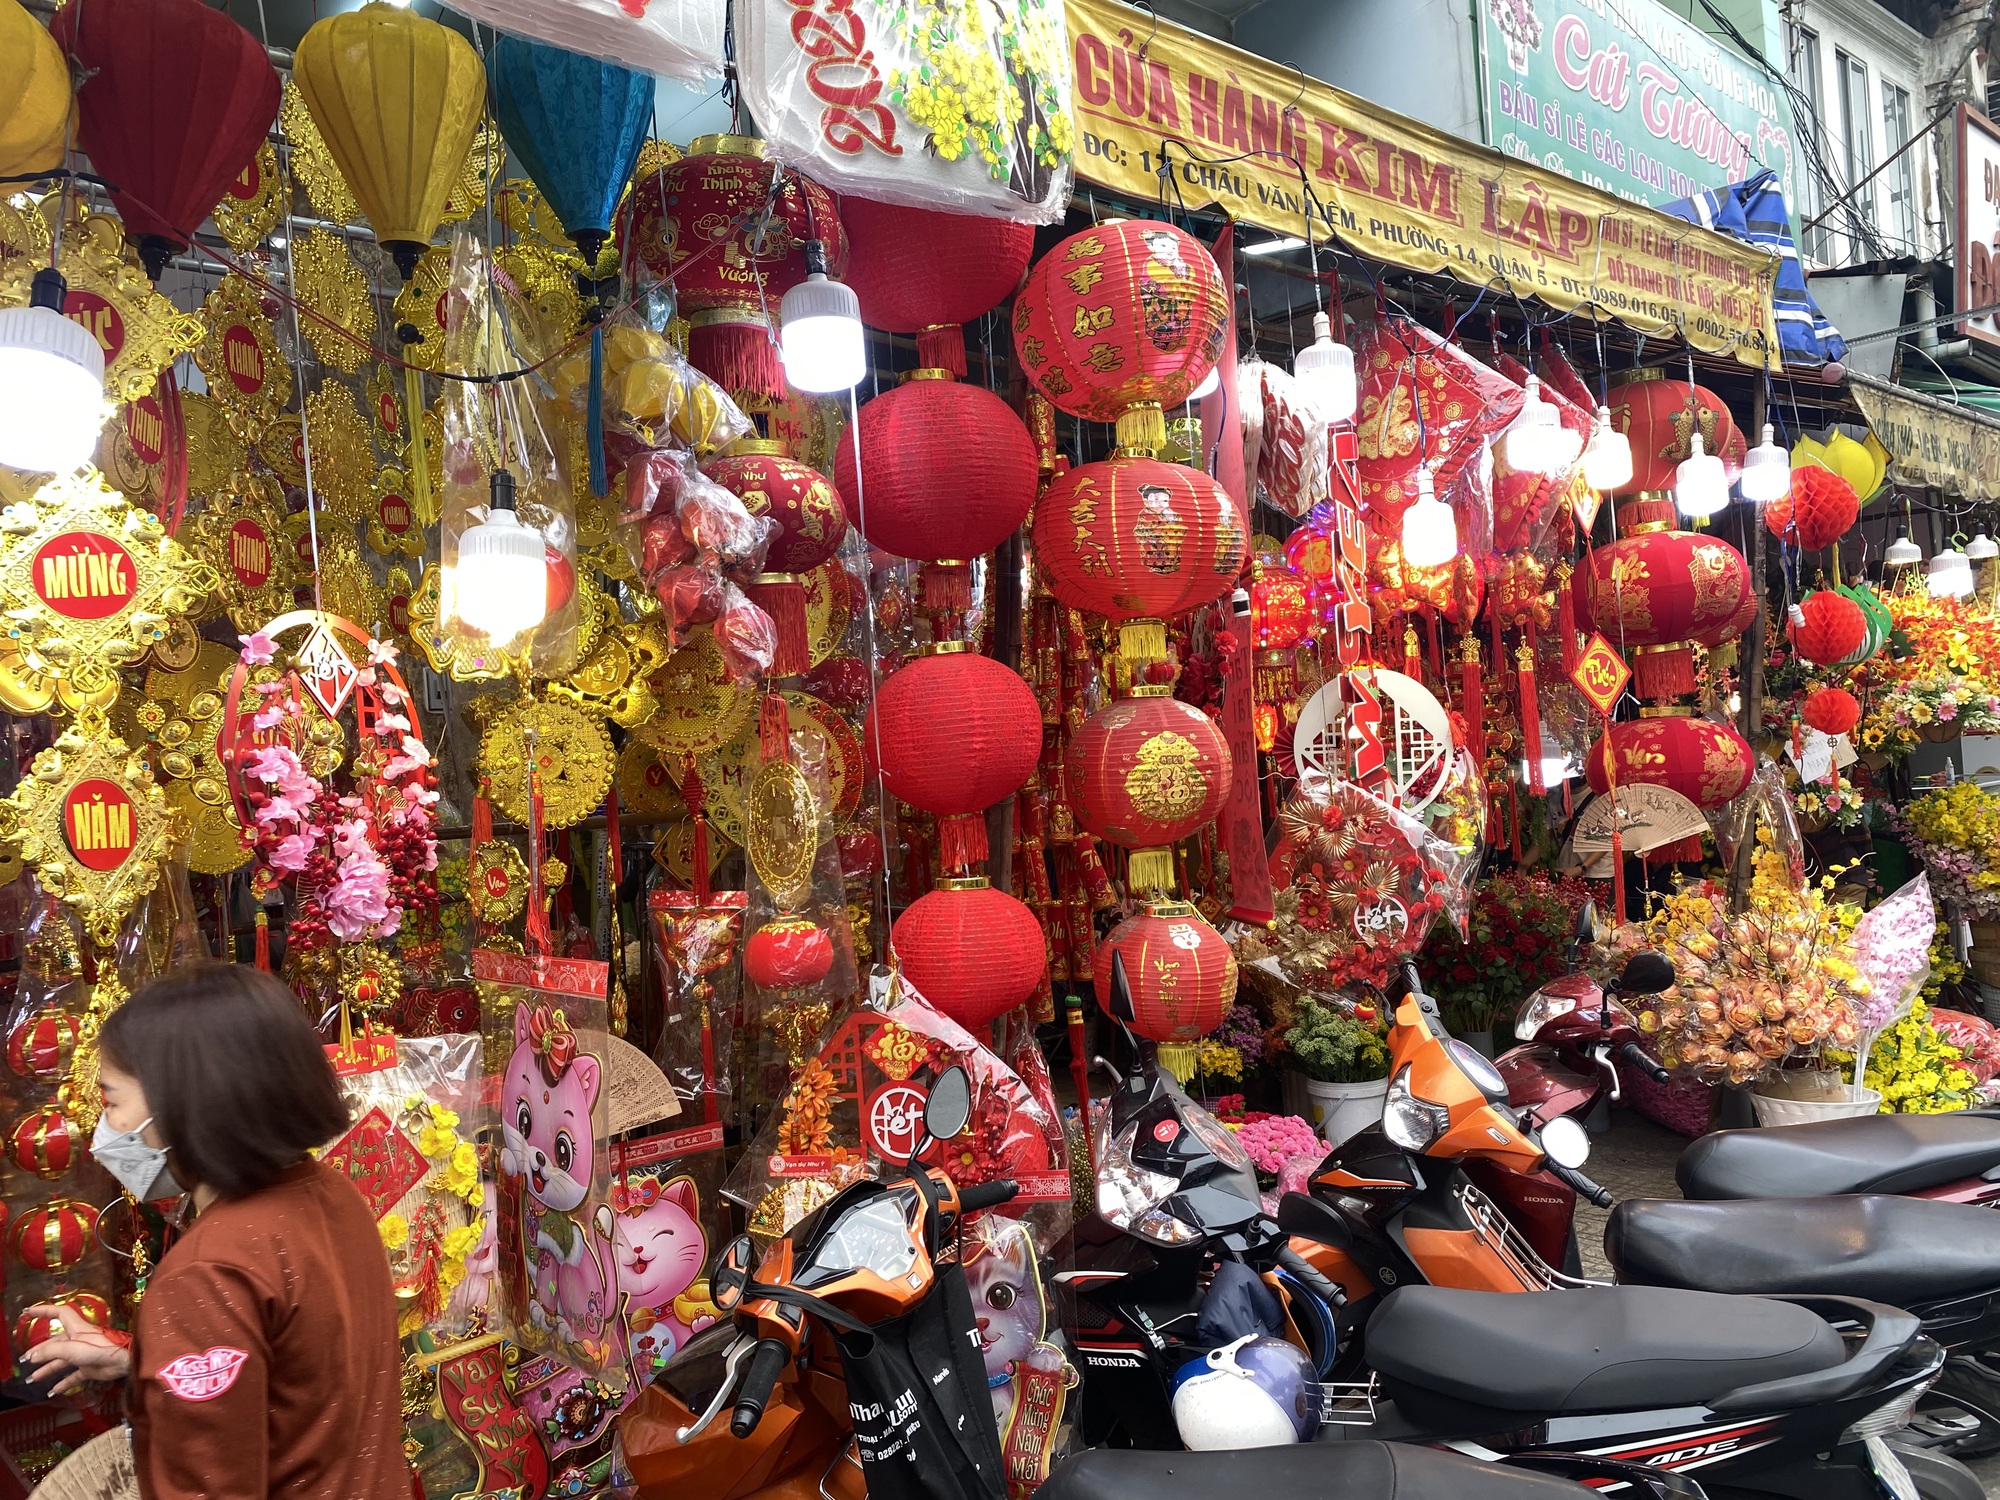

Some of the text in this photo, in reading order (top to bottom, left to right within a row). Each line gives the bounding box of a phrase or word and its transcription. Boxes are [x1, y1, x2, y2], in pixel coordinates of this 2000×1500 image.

[788, 0, 904, 155] 202
[1554, 14, 1631, 112] Cát
[1747, 79, 1780, 123] HOA
[1076, 28, 1593, 267] CỬA HÀNG KIM LẬP
[1499, 78, 1538, 130] BÁN
[1591, 129, 1625, 172] CÁC
[1629, 147, 1665, 193] LOẠI
[701, 176, 742, 193] Thịnh
[1083, 131, 1127, 166] ĐC:
[1183, 162, 1248, 198] CHÂU
[1257, 176, 1299, 214] VĂN
[1370, 217, 1449, 257] PHƯỜNG
[1455, 243, 1484, 270] 14,
[1488, 254, 1532, 283] QUẬN
[1537, 270, 1547, 286] 5
[717, 266, 769, 287] Vượng
[1626, 262, 1662, 298] TRANG
[228, 339, 261, 381] KHANG
[384, 505, 410, 526] KHANG
[1067, 477, 1114, 578] 大吉大利
[43, 540, 127, 599] MỪNG
[232, 531, 267, 578] THỊNH
[1586, 658, 1616, 687] Phúc
[76, 793, 130, 849] NĂM
[878, 1031, 915, 1062] 福
[1524, 1196, 1564, 1204] HONDA
[444, 1350, 501, 1393] Vạn
[1089, 1356, 1141, 1368] HONDA
[462, 1382, 505, 1427] Sự
[1027, 1378, 1054, 1407] Chúc
[476, 1408, 529, 1462] Như
[1021, 1403, 1050, 1434] Mừng
[1015, 1428, 1042, 1455] Năm
[501, 1447, 528, 1484] Ý
[1011, 1456, 1039, 1483] Mới
